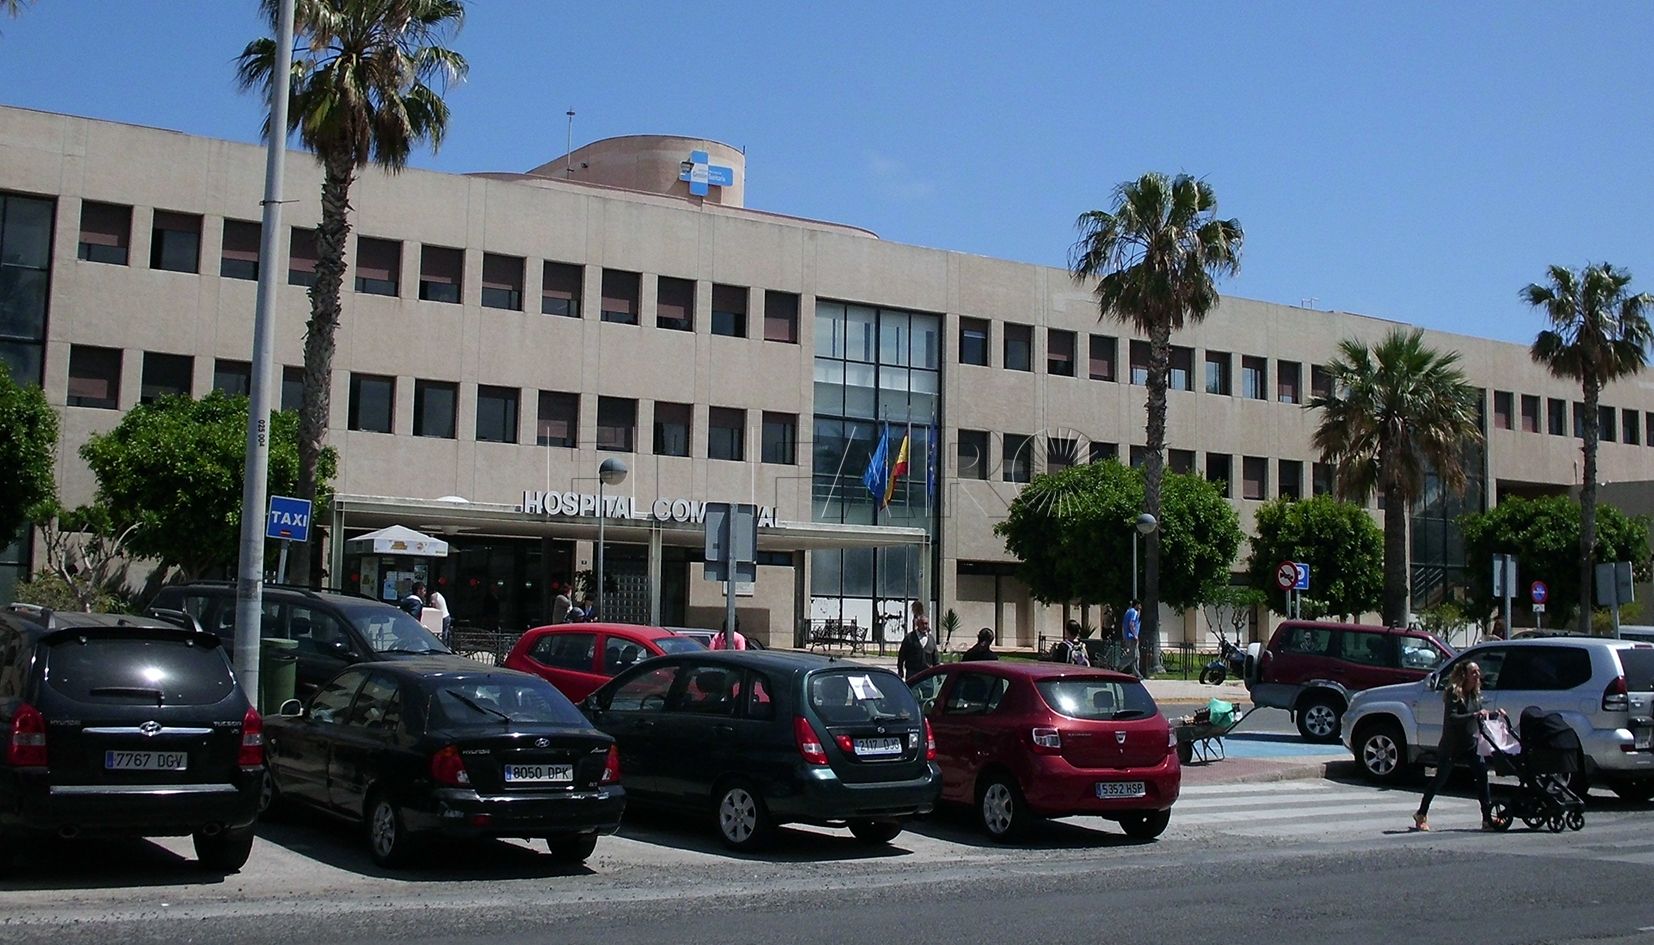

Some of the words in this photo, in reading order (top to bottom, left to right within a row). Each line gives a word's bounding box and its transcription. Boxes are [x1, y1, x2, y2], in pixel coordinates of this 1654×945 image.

[523, 490, 647, 520] HOSPITAL
[652, 496, 786, 528] COMAL
[271, 510, 307, 528] TAXI
[116, 753, 151, 767] 7767
[157, 753, 184, 768] DGV
[513, 766, 542, 779] 8050
[548, 766, 569, 779] DPK
[1102, 784, 1124, 794] 5352
[1126, 783, 1143, 794] HSP
